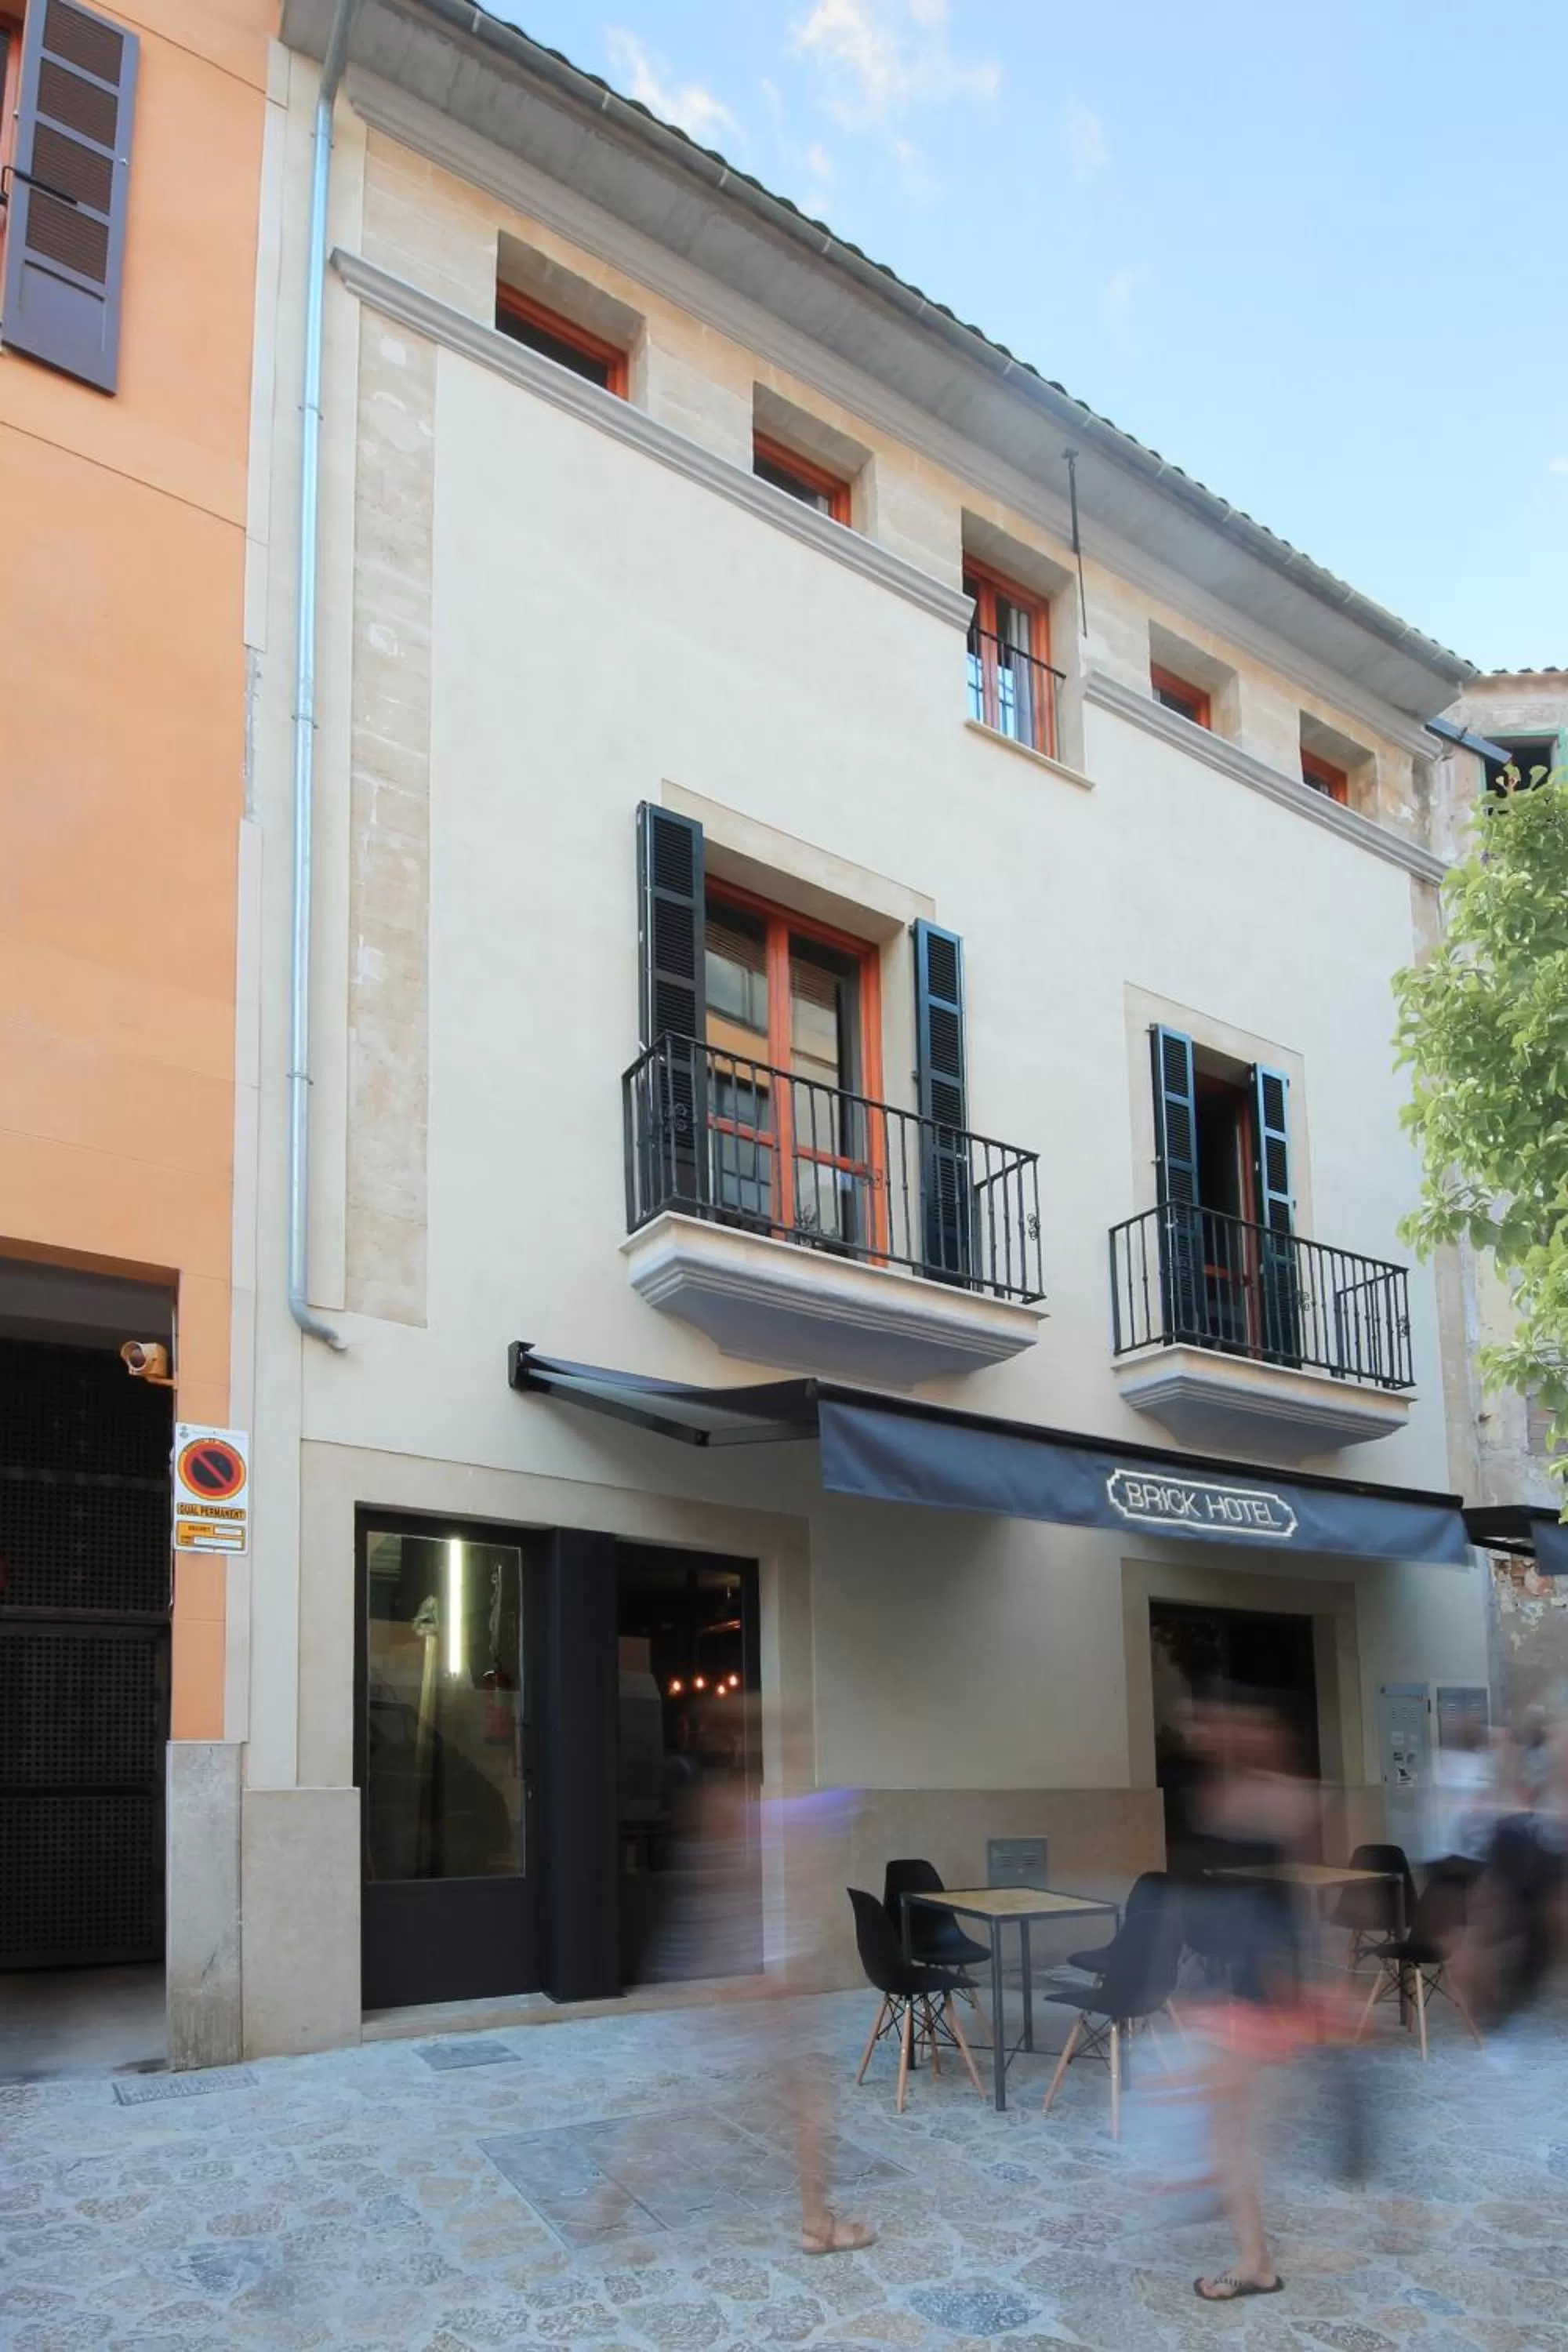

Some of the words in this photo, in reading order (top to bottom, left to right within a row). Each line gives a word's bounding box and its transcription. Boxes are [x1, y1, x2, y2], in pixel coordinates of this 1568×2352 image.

[201, 1505, 243, 1519] PERMANENT
[1125, 1482, 1201, 1518] BRICK
[1206, 1494, 1281, 1526] HOTEL
